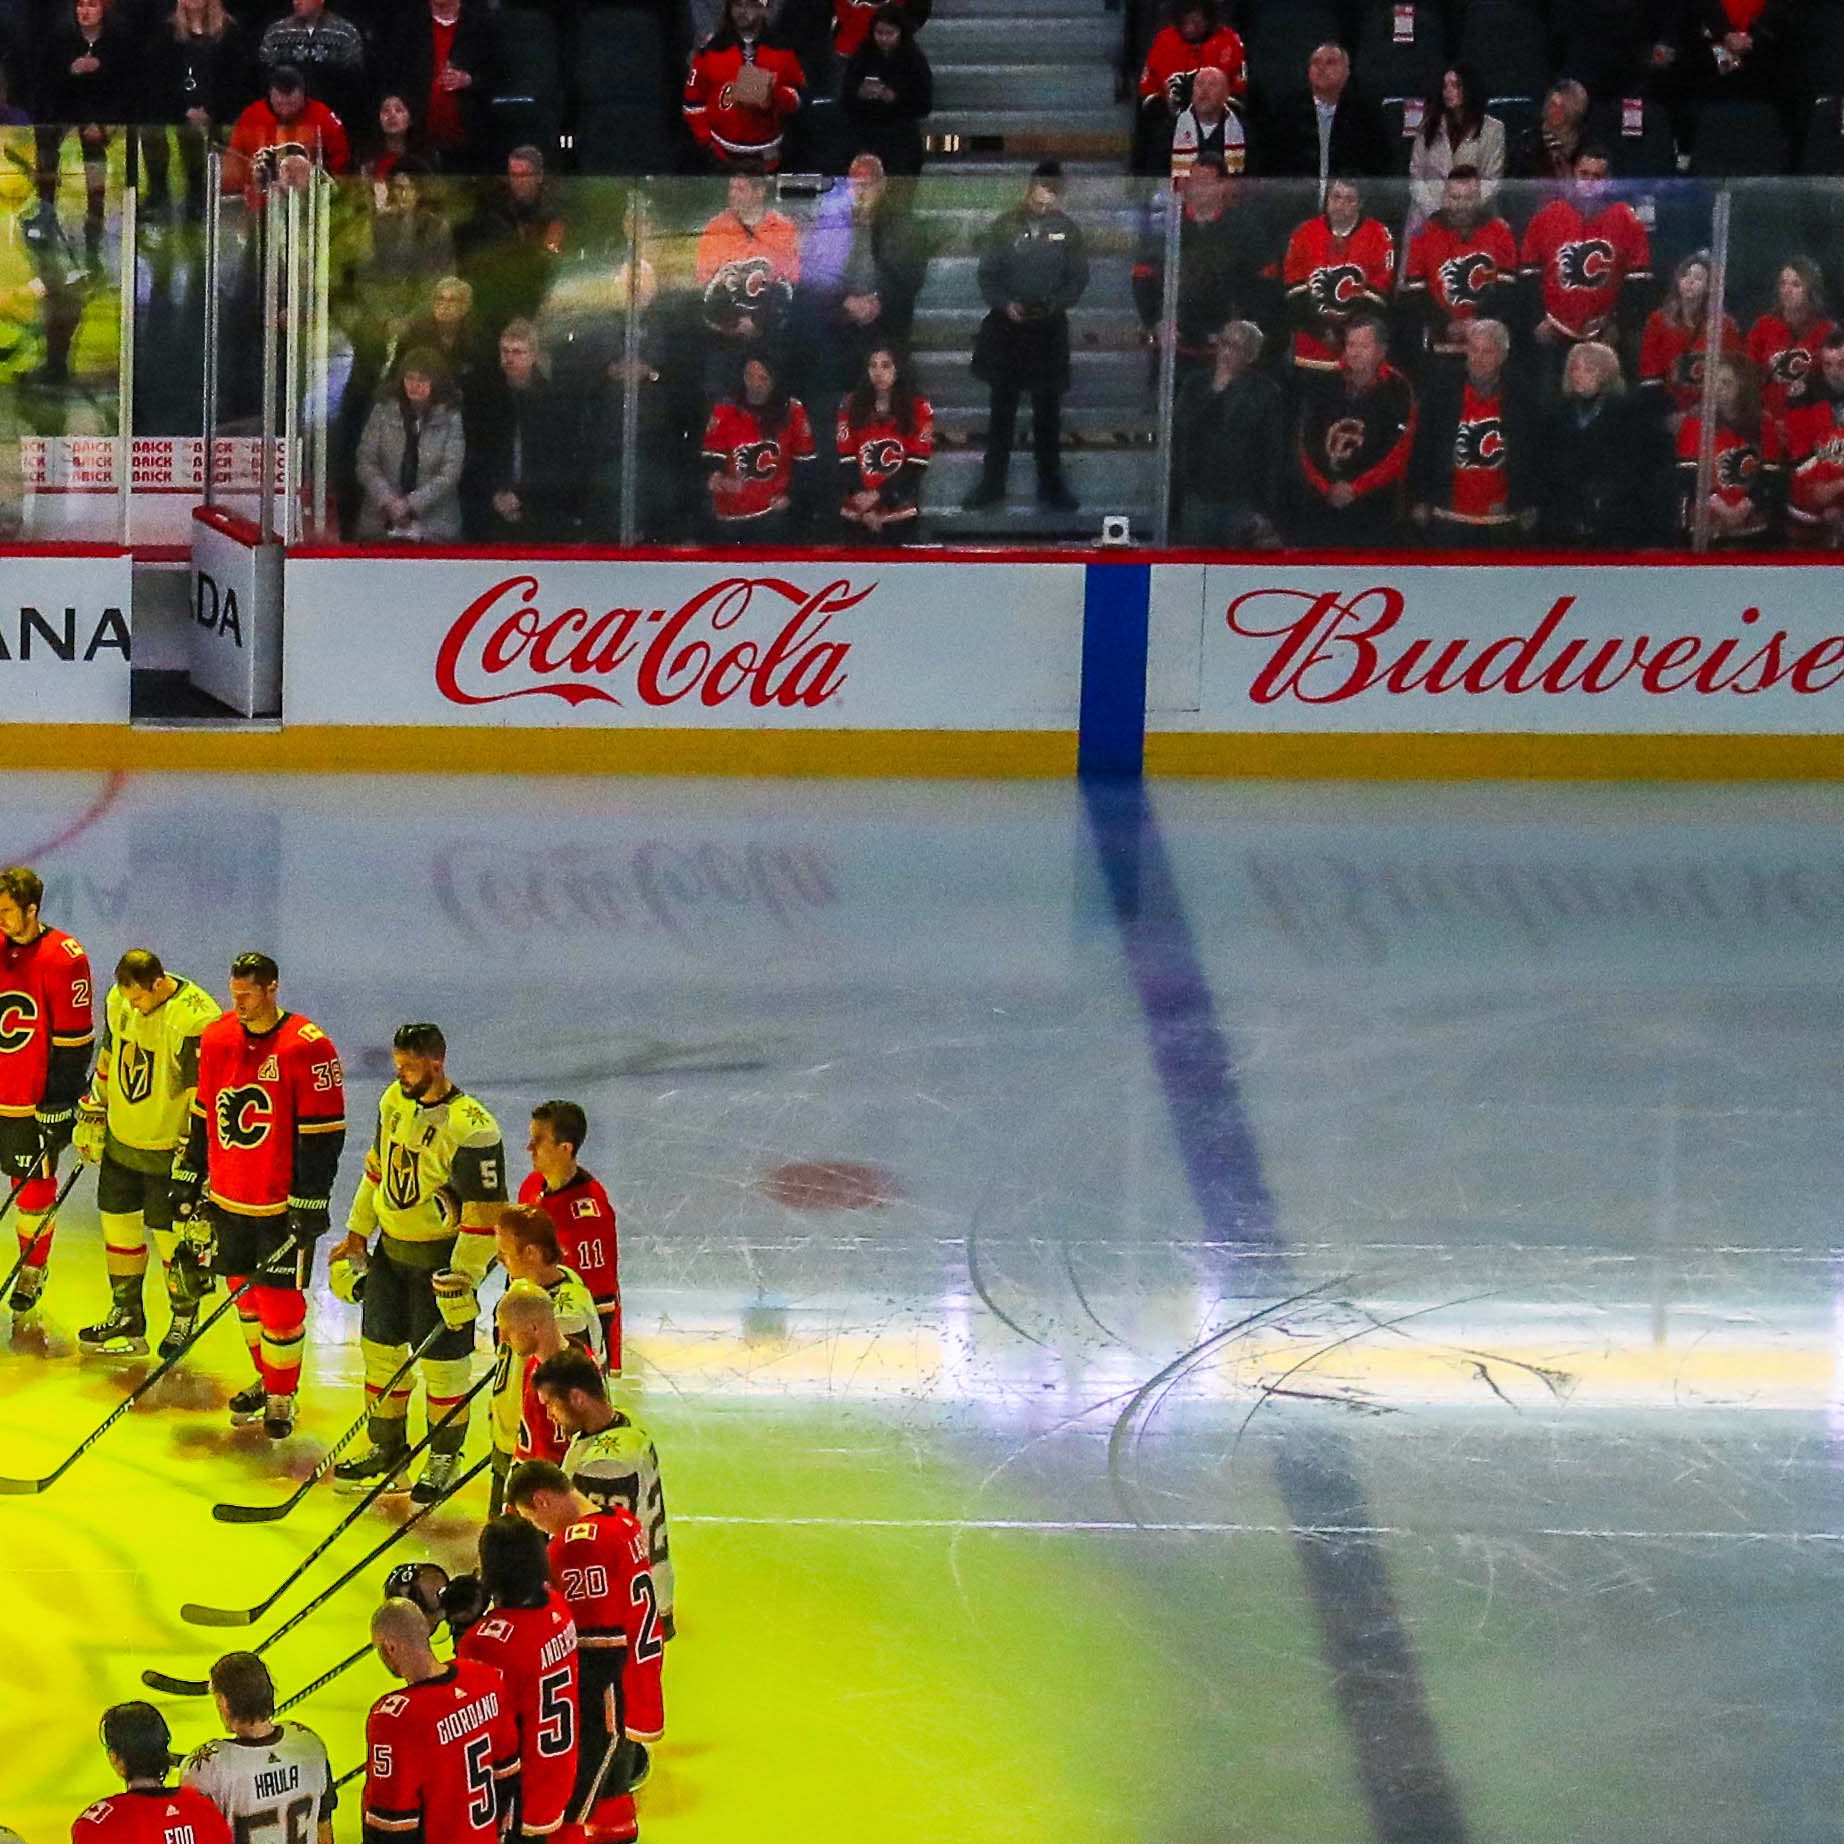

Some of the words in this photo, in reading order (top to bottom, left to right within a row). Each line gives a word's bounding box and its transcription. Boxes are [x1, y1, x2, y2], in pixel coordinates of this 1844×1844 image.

[435, 574, 877, 709] Coca-Cola
[480, 1159, 498, 1190] 5
[577, 1238, 605, 1270] 11
[562, 1564, 609, 1601] 20
[436, 1691, 499, 1745] GIORDANO
[254, 1765, 300, 1800] HAULA
